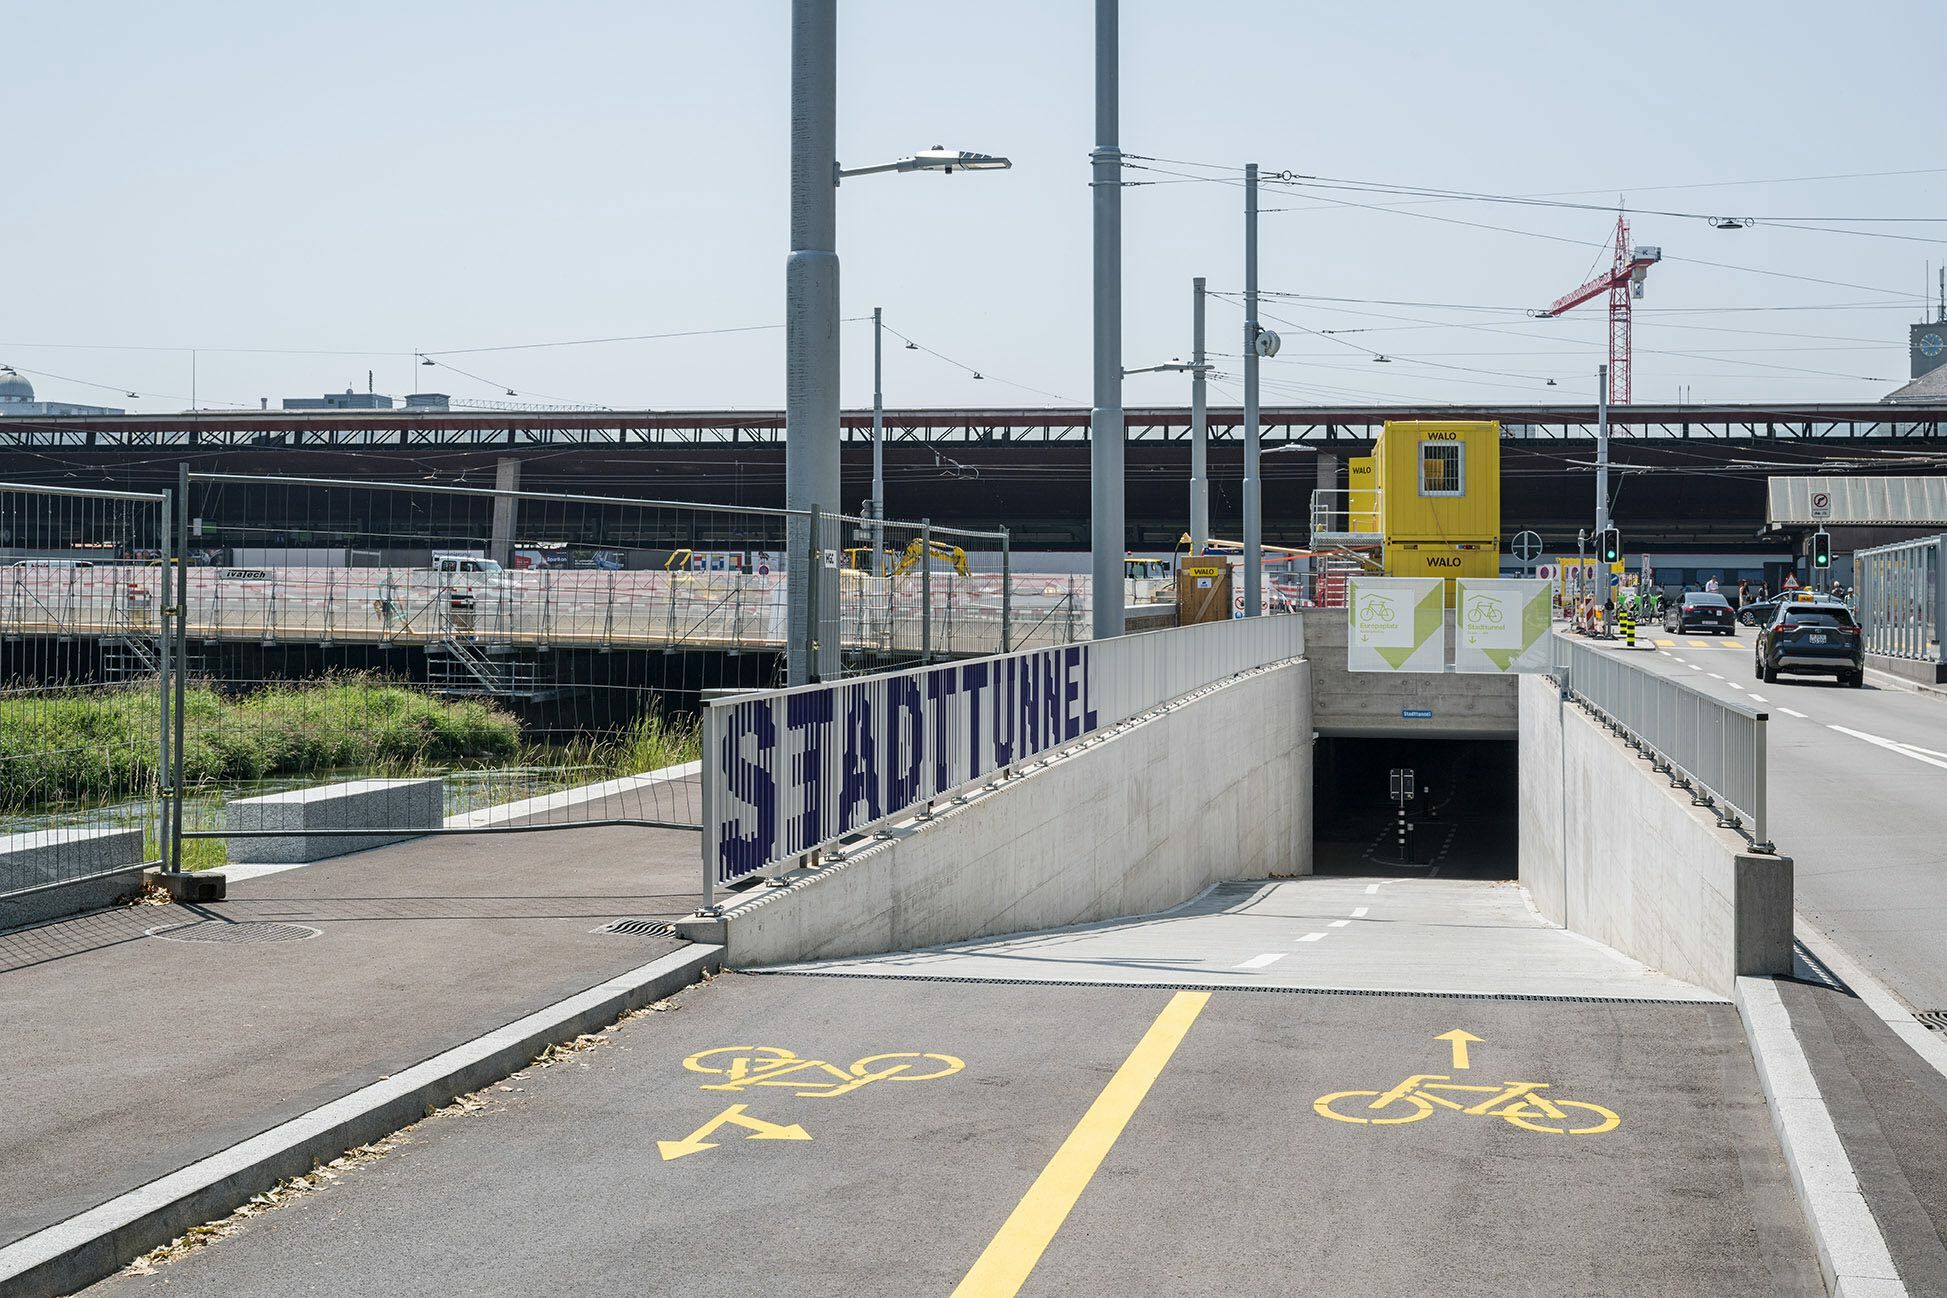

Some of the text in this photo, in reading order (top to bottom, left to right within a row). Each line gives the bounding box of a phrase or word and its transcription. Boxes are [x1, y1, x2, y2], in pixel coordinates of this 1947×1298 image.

[1428, 432, 1457, 441] WALO
[1352, 466, 1372, 474] WALO
[1426, 557, 1462, 567] WALO
[226, 569, 266, 579] ivaTech
[1193, 568, 1215, 576] WALO
[1467, 623, 1506, 631] Stadttunnel
[719, 645, 1098, 883] STADTTUNNEL
